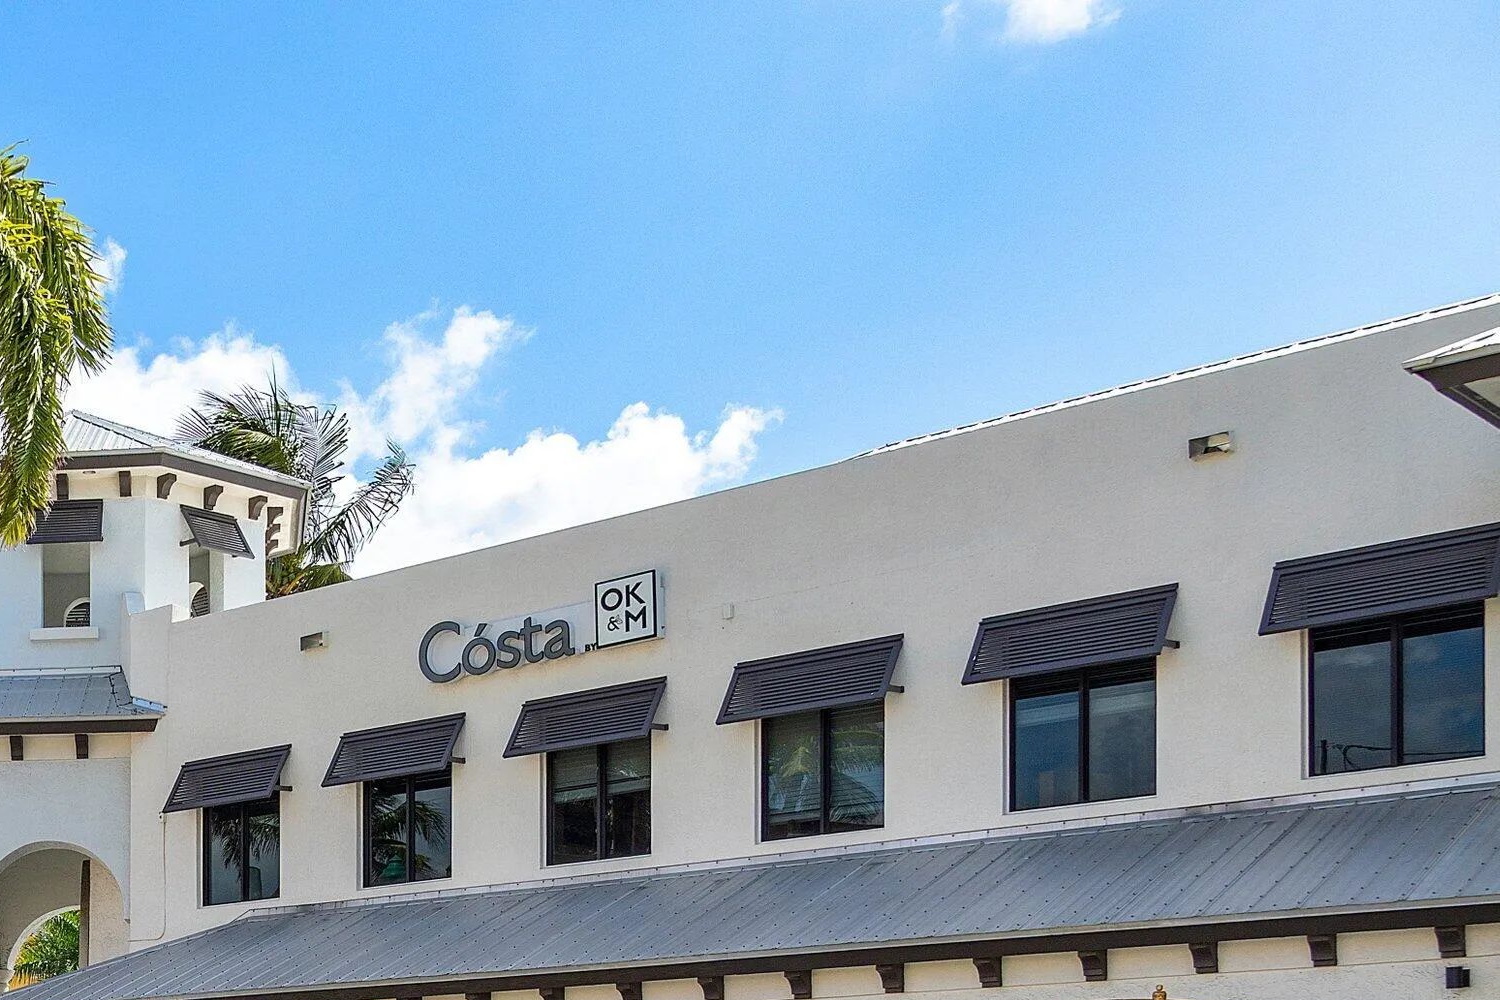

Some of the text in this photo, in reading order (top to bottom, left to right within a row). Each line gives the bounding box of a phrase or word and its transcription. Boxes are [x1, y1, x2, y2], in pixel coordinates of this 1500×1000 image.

[601, 581, 646, 611] OK
[418, 616, 598, 683] Cósta BY
